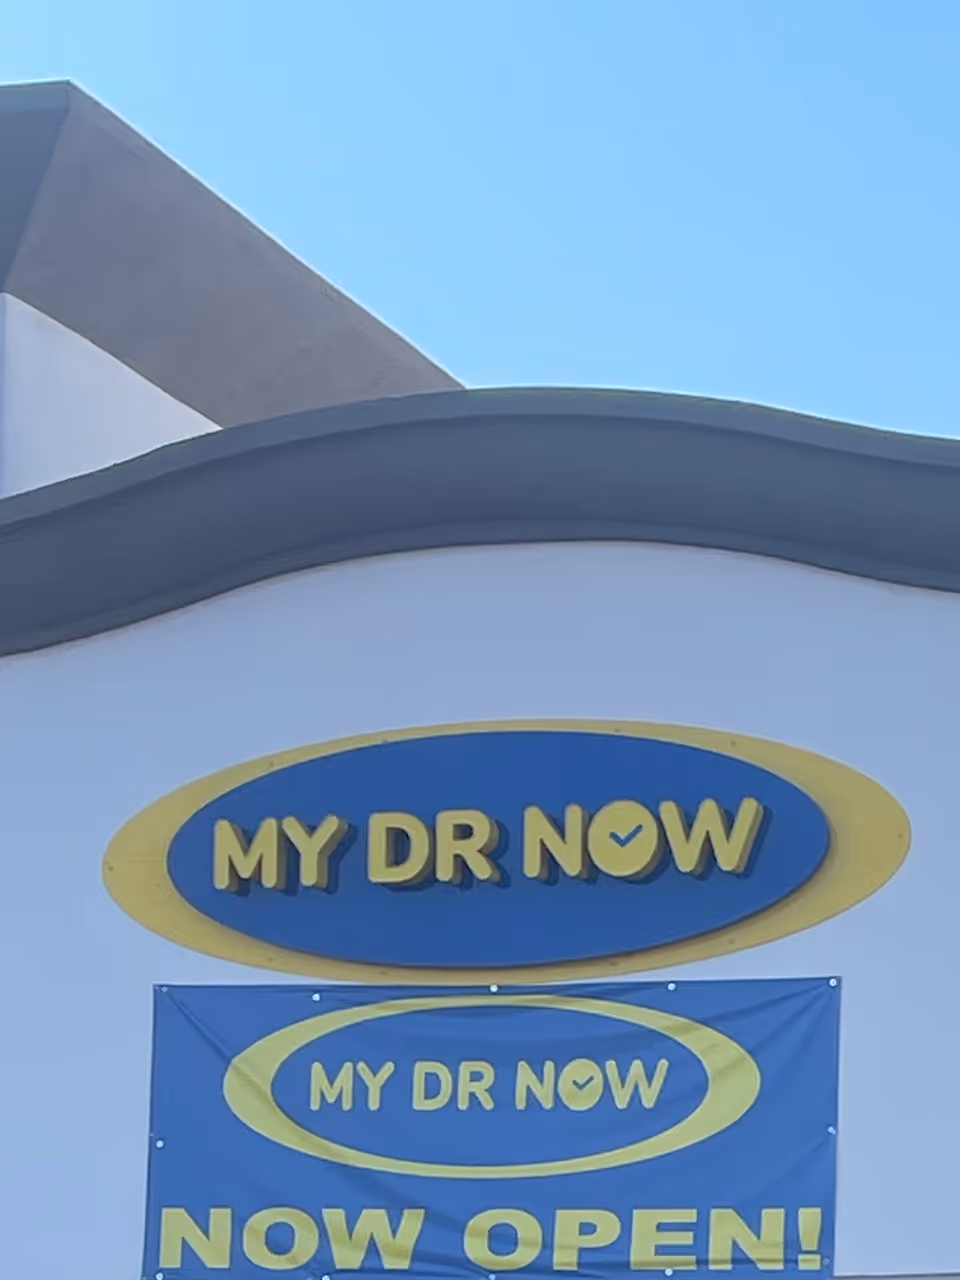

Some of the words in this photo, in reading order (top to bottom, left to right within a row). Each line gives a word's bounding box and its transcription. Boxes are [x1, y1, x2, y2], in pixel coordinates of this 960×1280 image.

[213, 812, 342, 891] MY
[366, 807, 499, 884] DR
[522, 797, 764, 879] NOW
[308, 1060, 395, 1112] MY
[412, 1060, 494, 1111] DR
[515, 1057, 670, 1112] NOW
[158, 1206, 426, 1270] NOW
[462, 1206, 823, 1272] OPEN!
